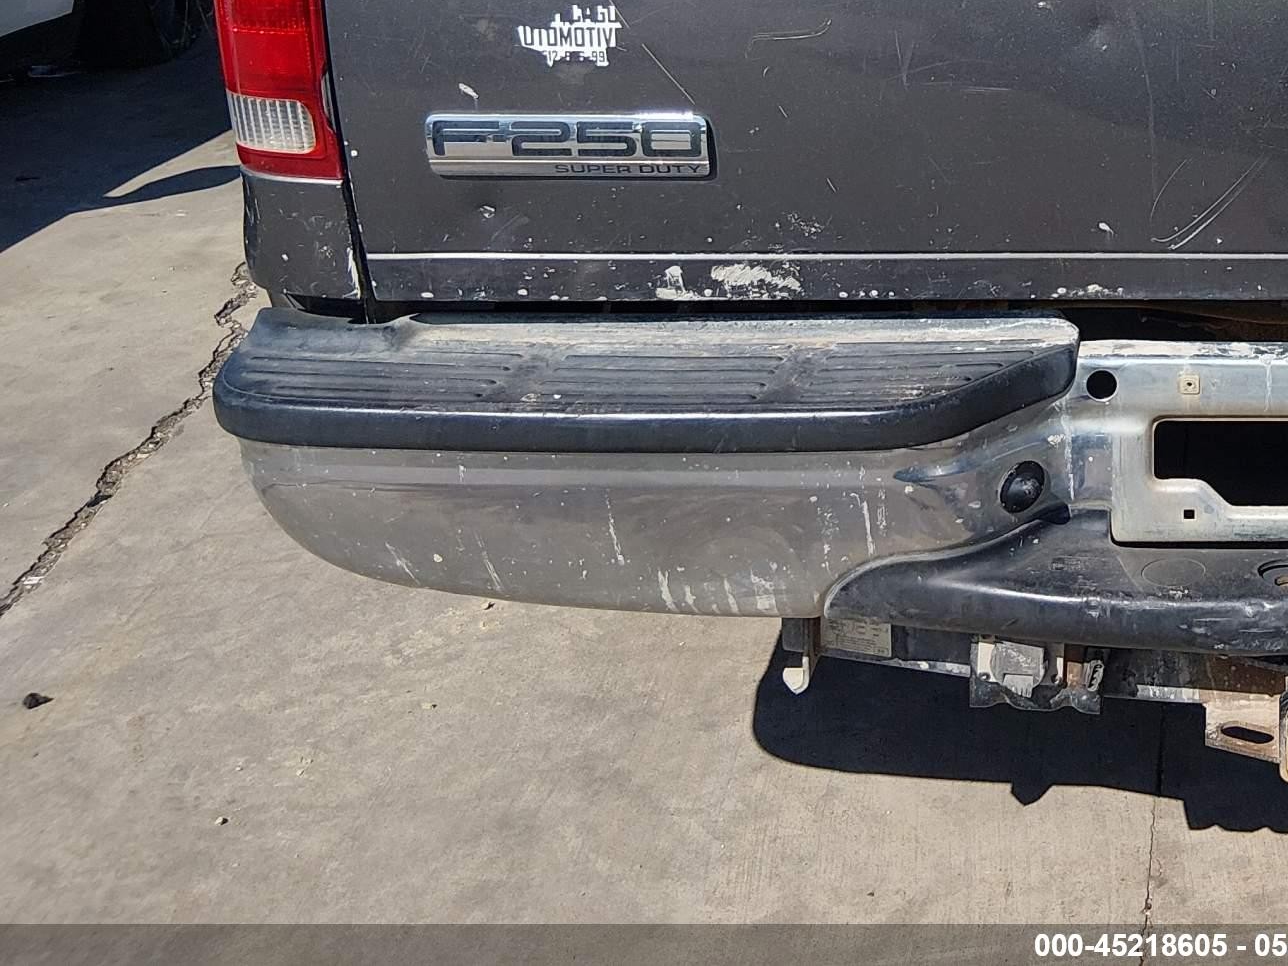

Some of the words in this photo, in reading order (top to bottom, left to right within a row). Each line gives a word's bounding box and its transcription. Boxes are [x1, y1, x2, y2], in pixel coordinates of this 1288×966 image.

[431, 120, 703, 157] F-250
[554, 164, 631, 174] SUPER
[638, 164, 701, 174] DUTY
